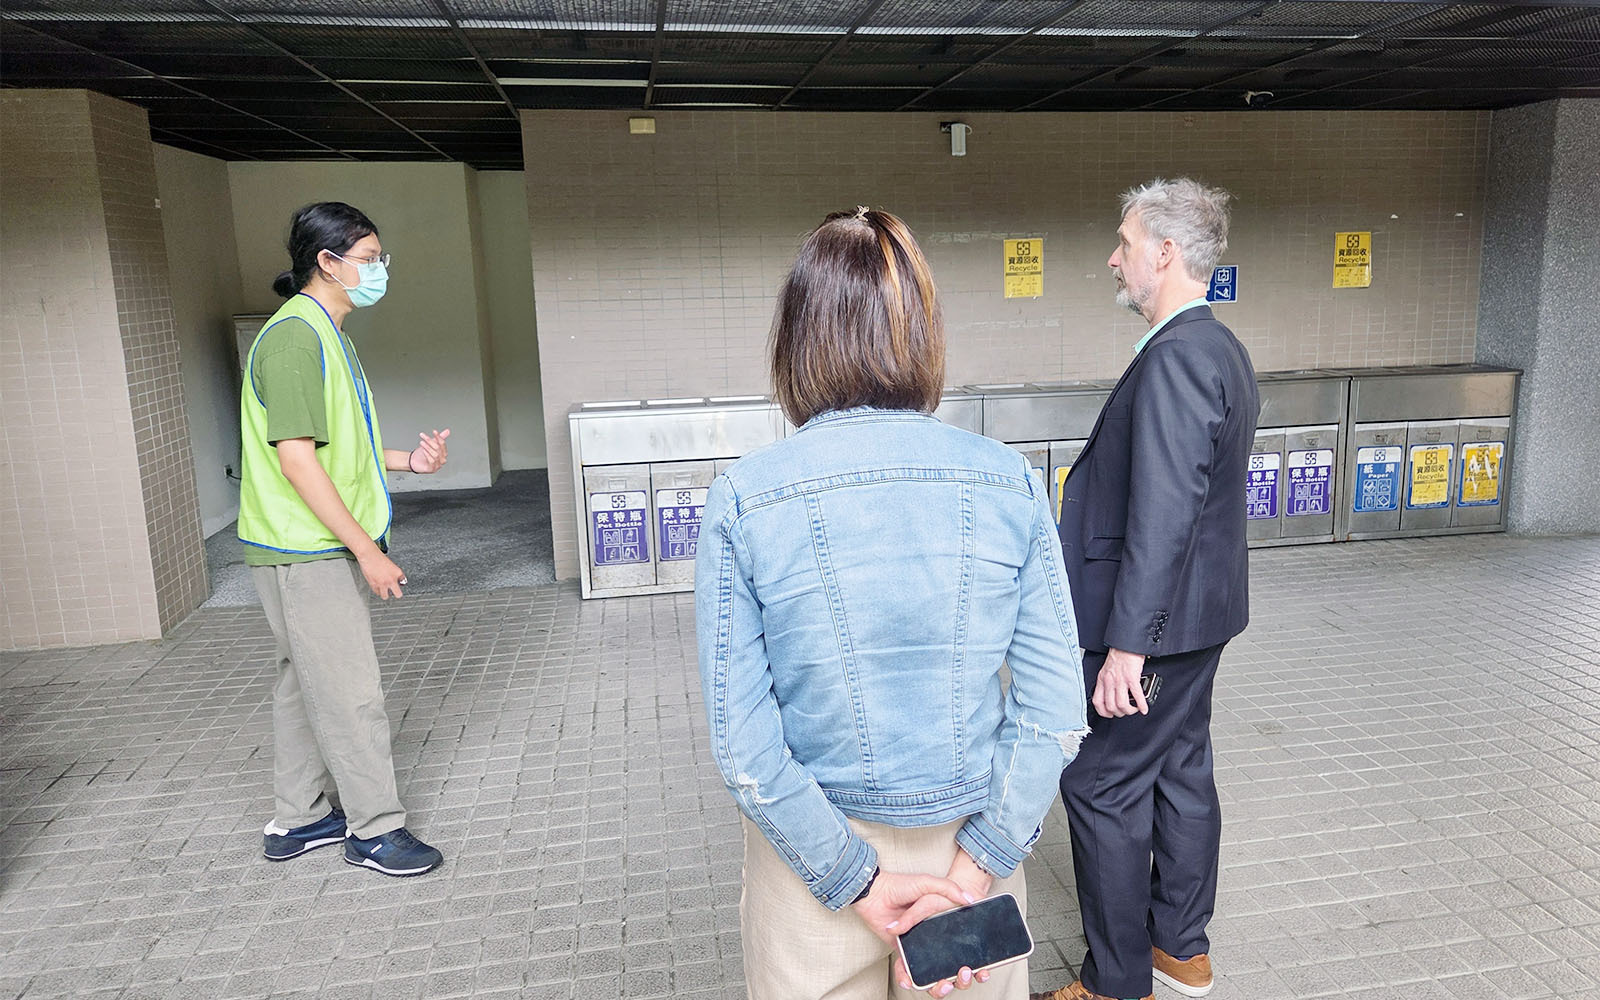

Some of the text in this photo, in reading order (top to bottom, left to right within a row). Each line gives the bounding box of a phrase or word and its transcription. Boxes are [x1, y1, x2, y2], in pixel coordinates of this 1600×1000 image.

[1339, 248, 1367, 256] 資源回收
[1008, 256, 1039, 265] 資源回收
[1292, 467, 1328, 478] 保特瓶
[1417, 465, 1445, 474] 資源回收
[1417, 472, 1444, 480] Recycle
[597, 511, 642, 523] 保特瓶
